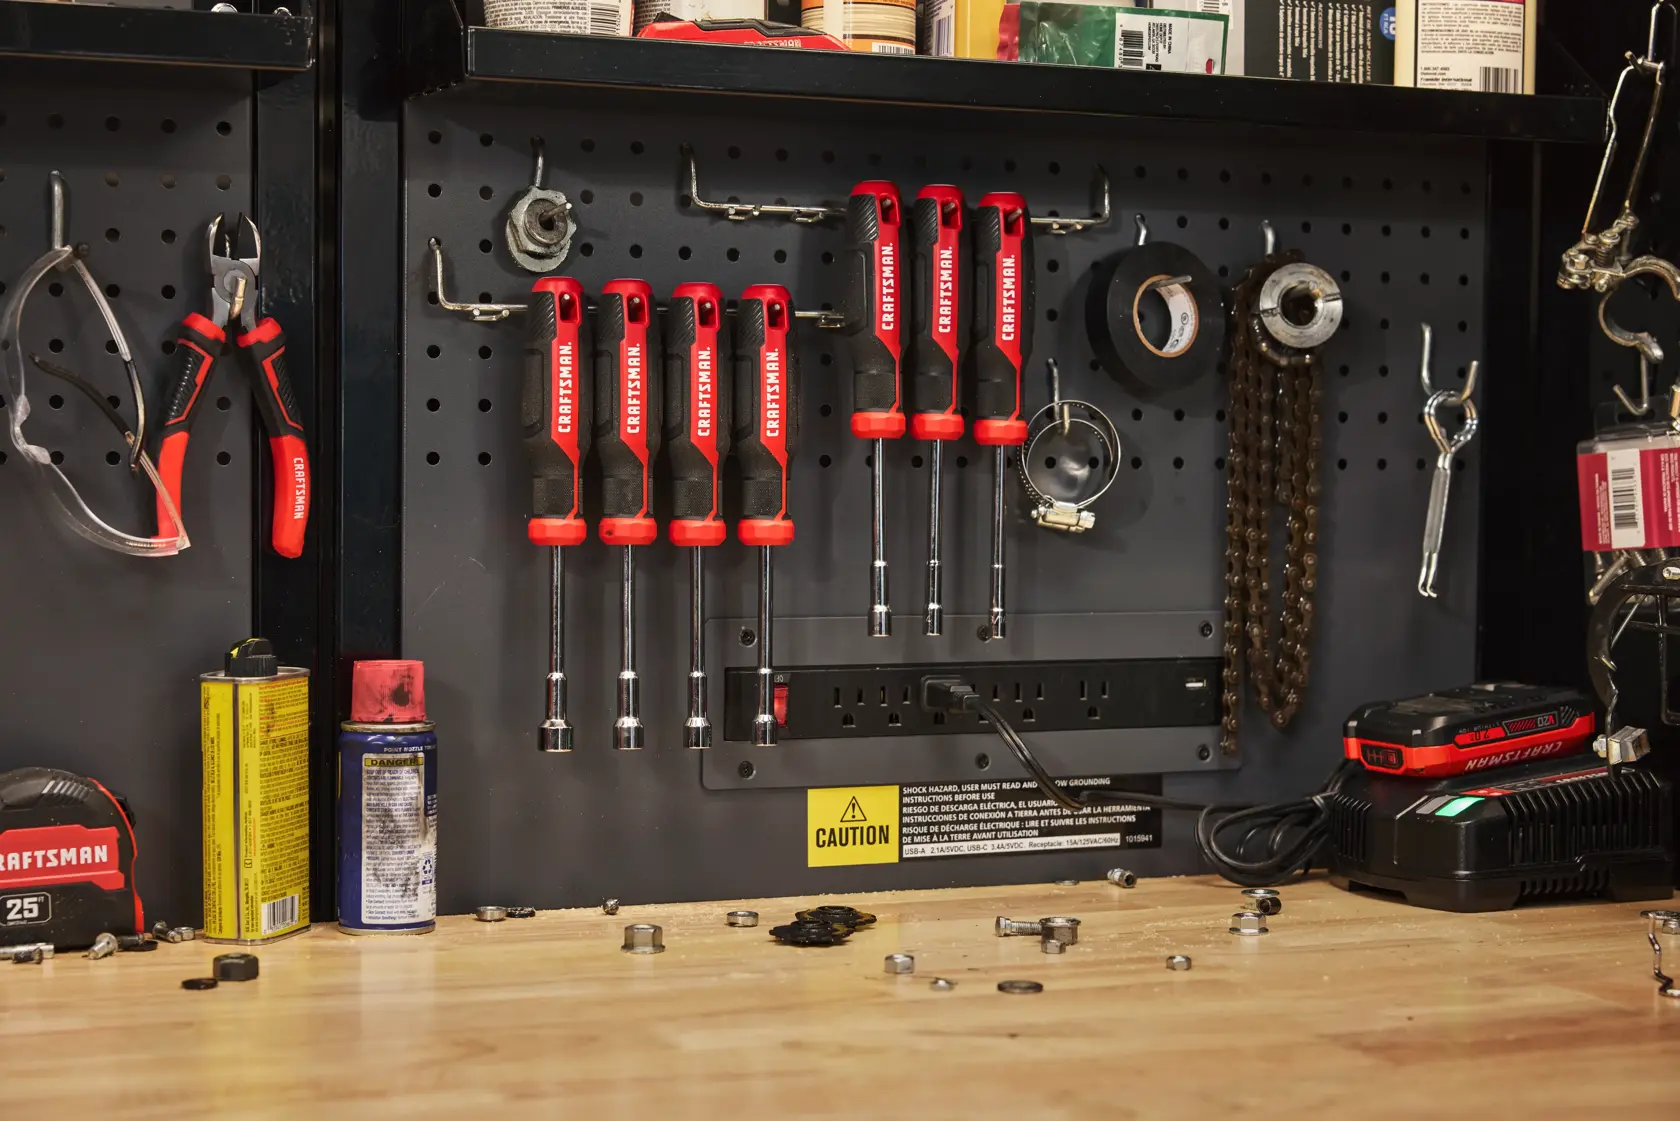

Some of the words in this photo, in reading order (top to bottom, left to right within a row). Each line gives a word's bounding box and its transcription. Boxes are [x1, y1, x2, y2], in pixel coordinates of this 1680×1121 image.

[293, 458, 306, 519] CRAFTSMAN
[1537, 715, 1554, 727] V20
[1464, 741, 1562, 770] CRAFTSMAN
[929, 785, 960, 793] HAZARD,
[961, 784, 979, 792] USER
[1002, 782, 1020, 790] READ
[1069, 778, 1110, 786] GROUNDING
[903, 794, 953, 804] INSTRUCTIONS
[954, 793, 980, 801] BEFORE
[903, 806, 928, 814] RIESGO
[930, 805, 939, 813] DE
[941, 804, 978, 812] DESCARGA
[980, 801, 1017, 810] ELÉCTRICA,
[903, 814, 957, 823] INSTRUCCIONES
[970, 812, 1006, 820] CONEXIÓN
[1014, 809, 1037, 817] TIERRA
[1039, 808, 1061, 816] ANTES
[1074, 807, 1091, 815] AR
[903, 826, 928, 834] RISQUE
[941, 822, 978, 832] DÉCHARGE
[1041, 819, 1049, 827] ET
[1050, 818, 1074, 826] SUIVRE
[1089, 815, 1136, 824] INSTRUCTIONS
[816, 825, 889, 848] CAUTION
[997, 829, 1038, 838] UTILISATION
[1125, 834, 1153, 842] 1015941
[930, 846, 965, 854] 2.1A/5VDC,
[7, 897, 38, 920] 25
